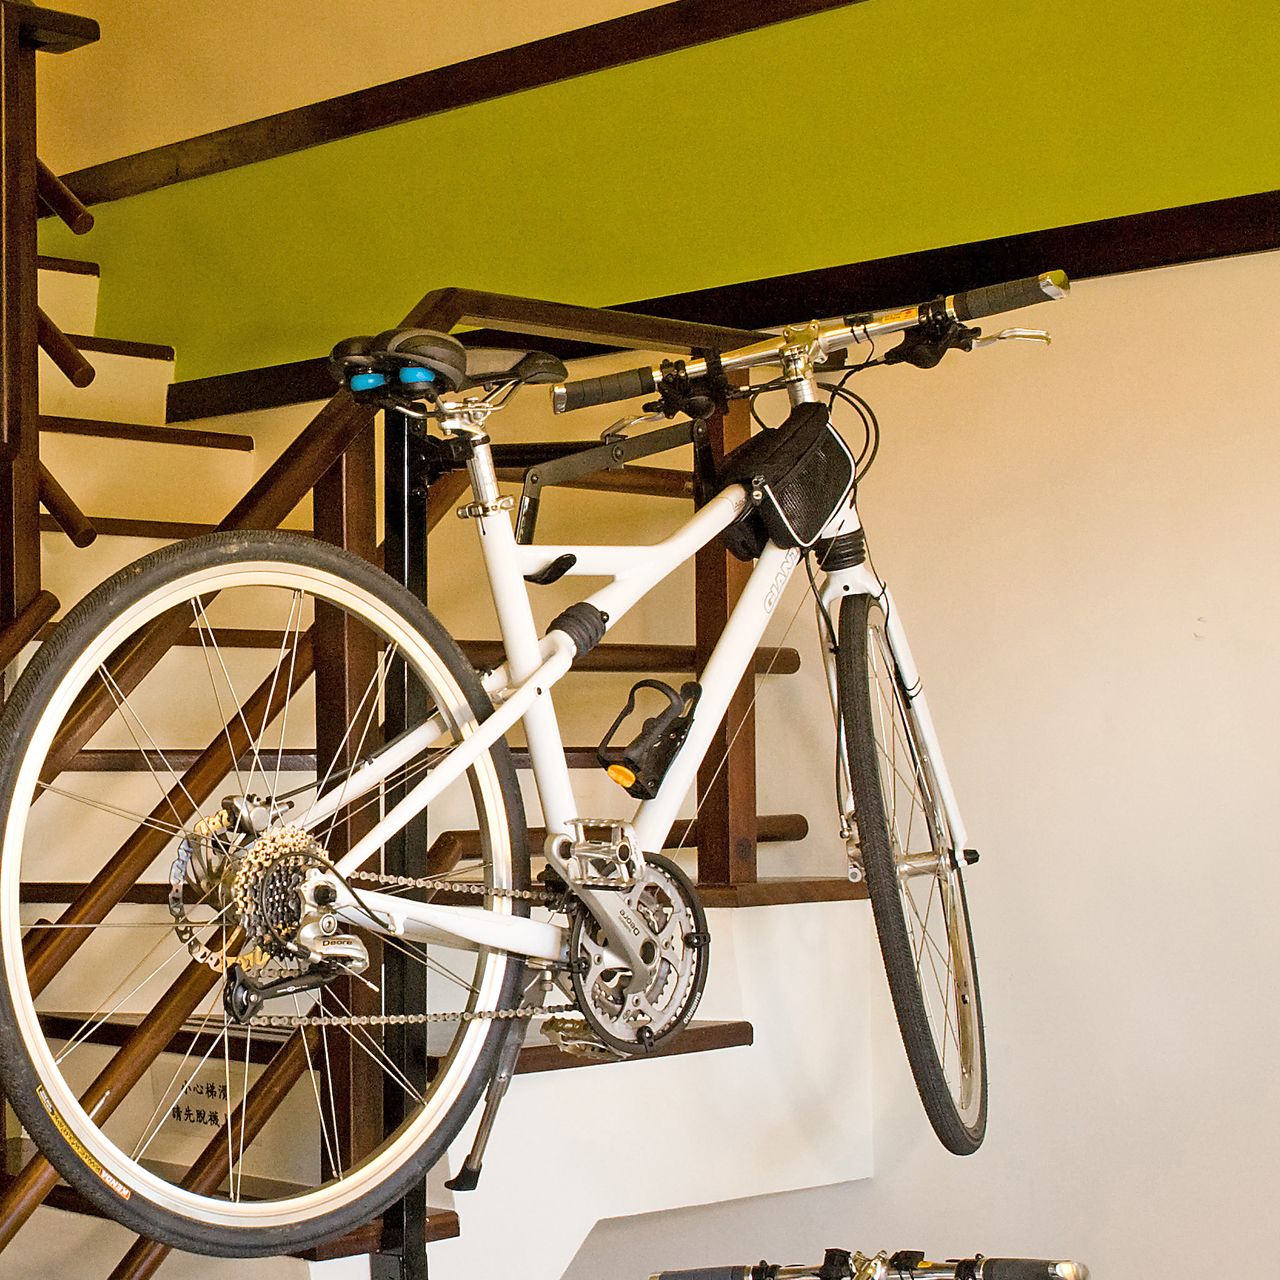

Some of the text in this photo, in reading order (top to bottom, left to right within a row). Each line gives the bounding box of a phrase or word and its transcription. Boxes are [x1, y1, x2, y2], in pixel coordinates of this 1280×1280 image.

[620, 909, 641, 937] Deore
[322, 939, 353, 947] Deore
[100, 1169, 130, 1197] KENDA
